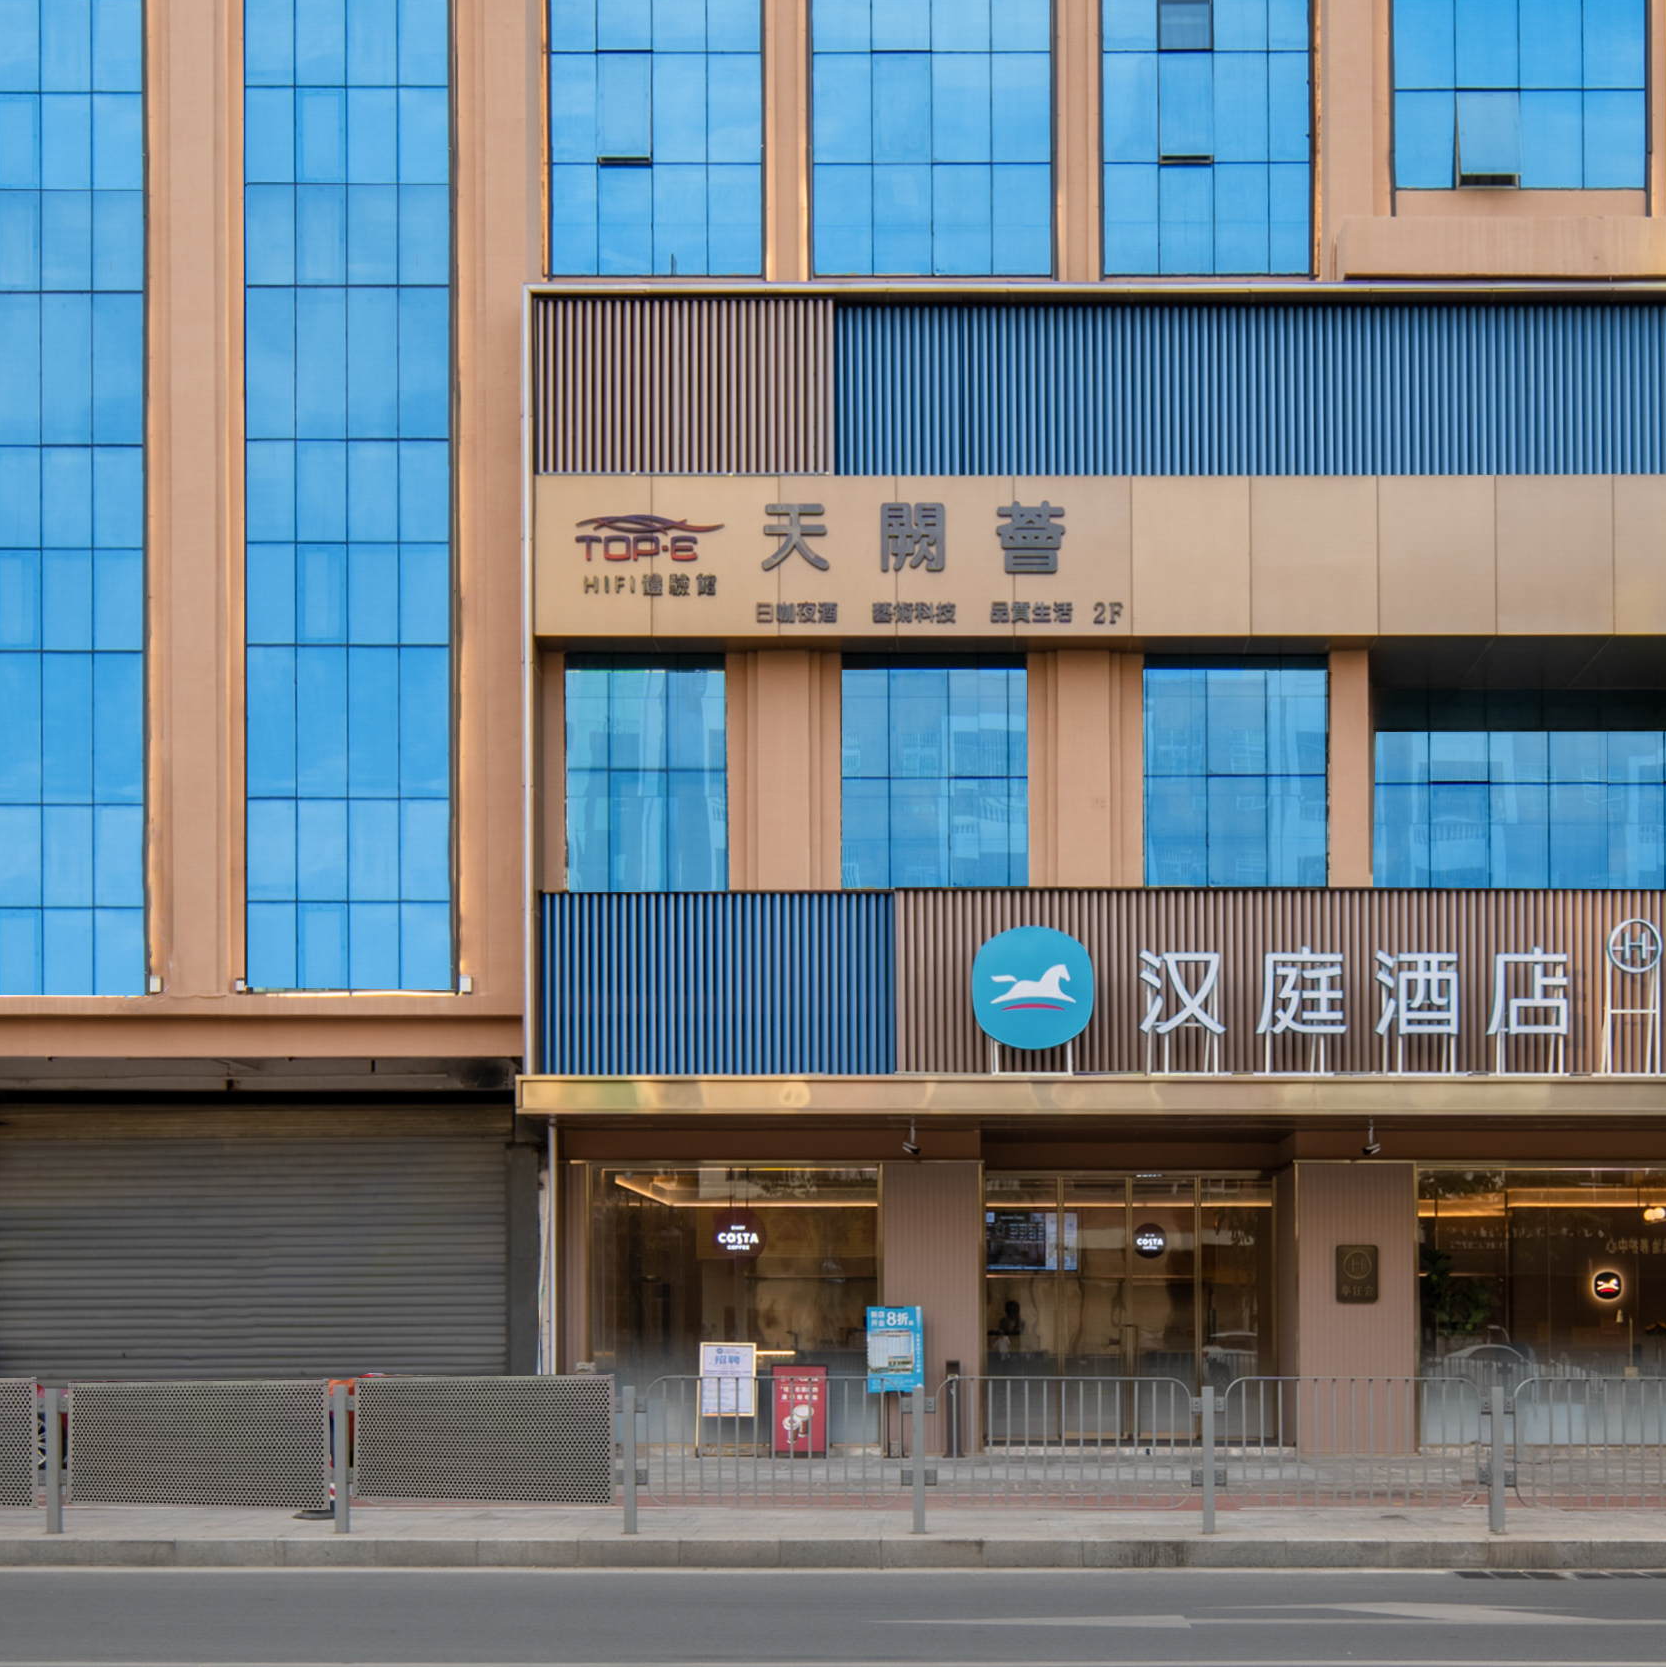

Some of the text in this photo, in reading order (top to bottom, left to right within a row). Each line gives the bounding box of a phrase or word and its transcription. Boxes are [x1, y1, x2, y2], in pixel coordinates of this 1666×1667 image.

[755, 600, 1124, 625] 日咖夜酒 藝術科技 品質生活 2F
[1139, 946, 1569, 1036] 汉庭酒店
[717, 1232, 759, 1244] COSTA
[1136, 1238, 1164, 1246] COSTA
[714, 1355, 741, 1365] 招聘
